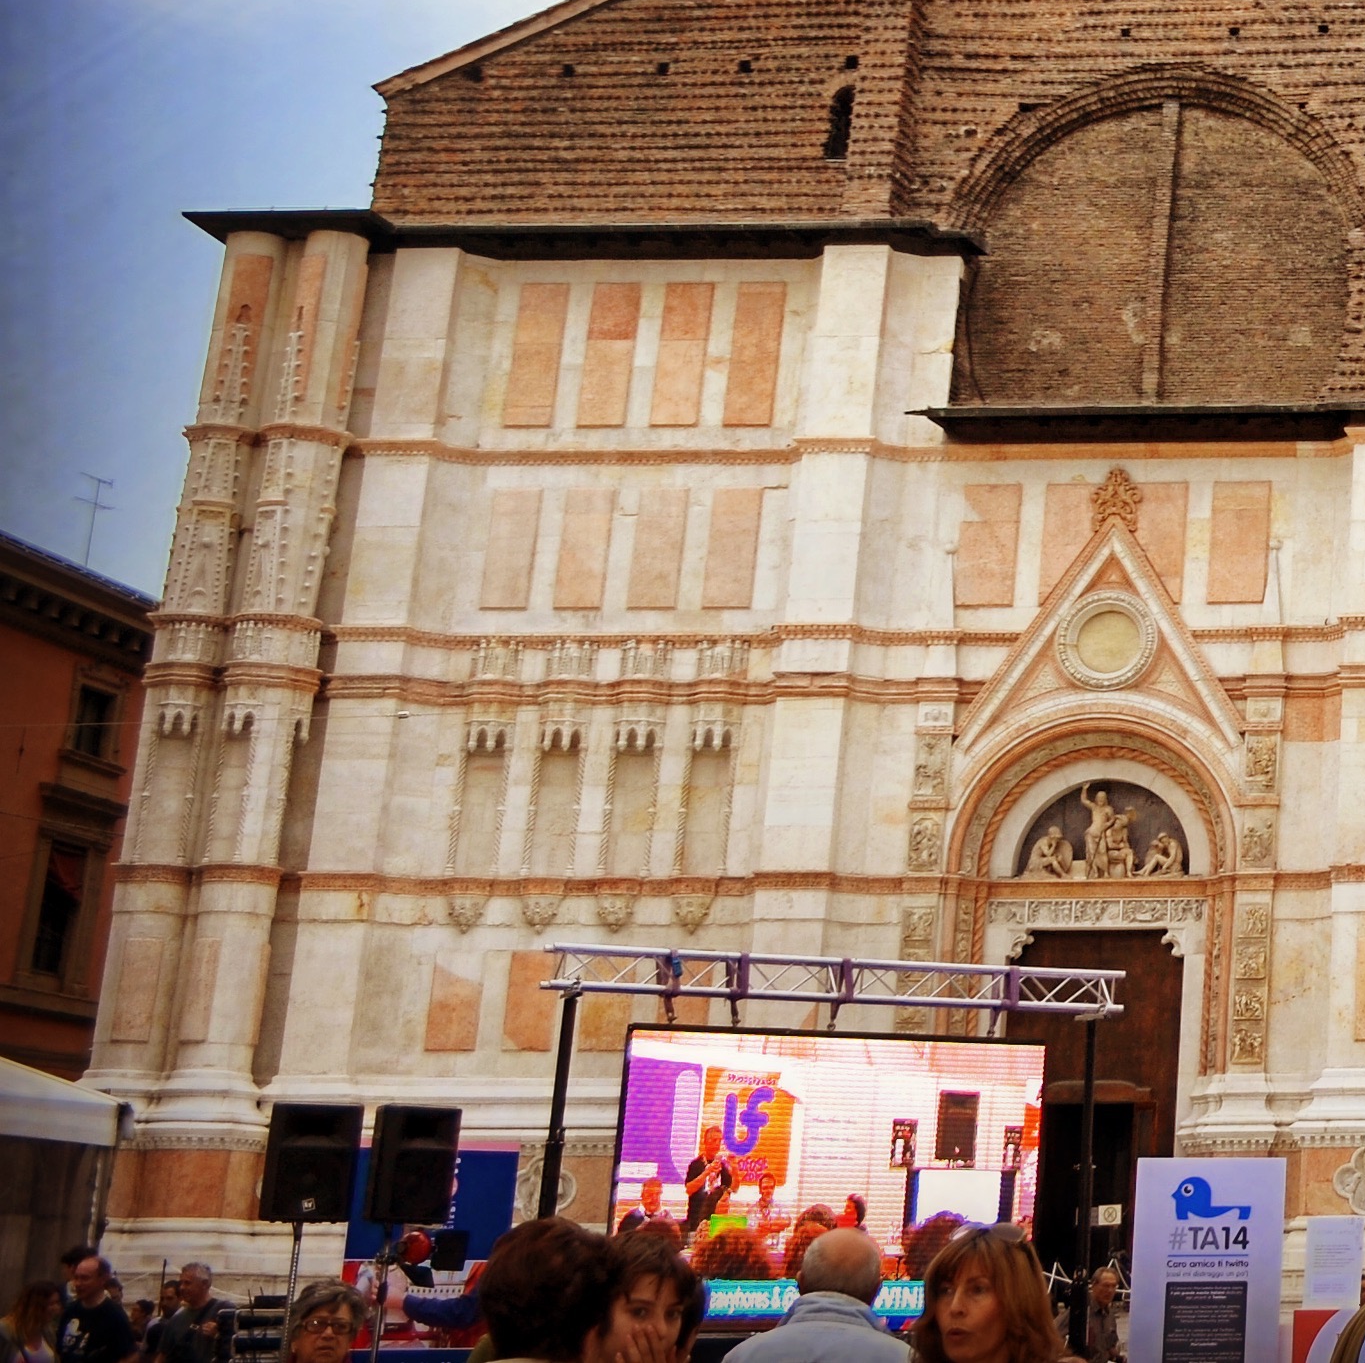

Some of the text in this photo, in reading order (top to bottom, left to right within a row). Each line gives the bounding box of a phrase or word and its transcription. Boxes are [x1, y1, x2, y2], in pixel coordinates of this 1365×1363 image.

[1168, 1226, 1250, 1250] #TA14
[1166, 1259, 1249, 1268] Caro amico ti twitto
